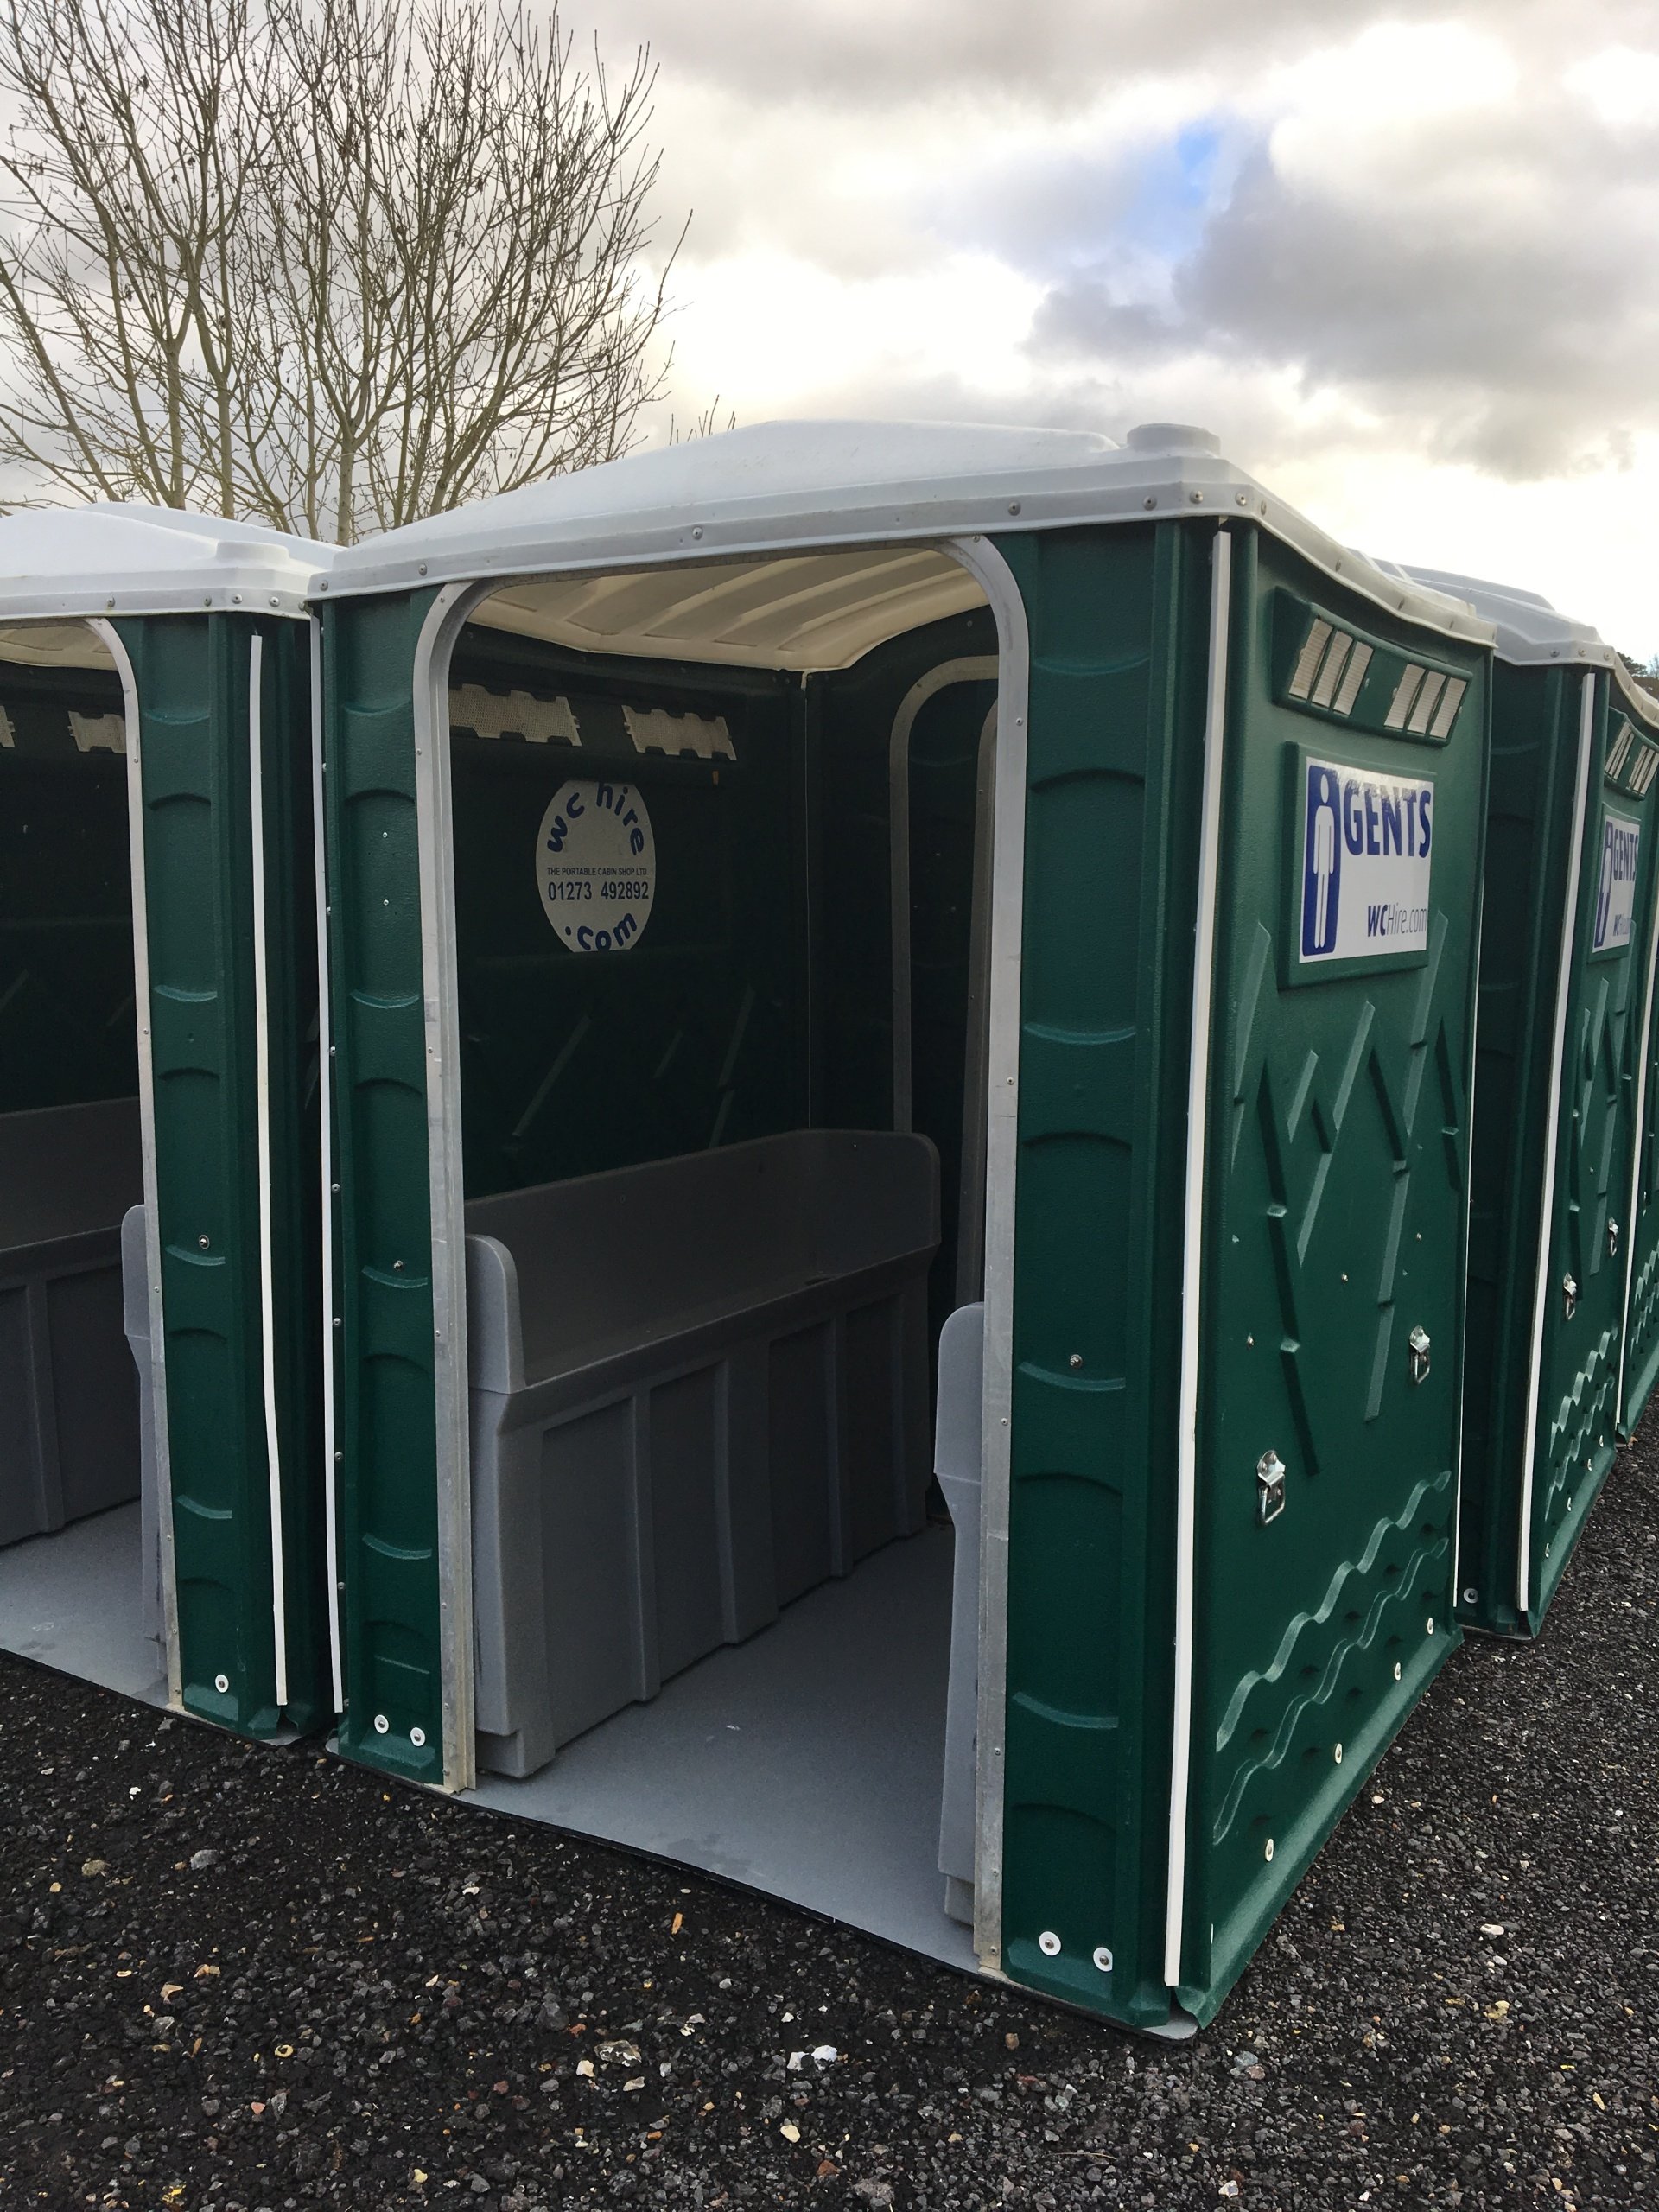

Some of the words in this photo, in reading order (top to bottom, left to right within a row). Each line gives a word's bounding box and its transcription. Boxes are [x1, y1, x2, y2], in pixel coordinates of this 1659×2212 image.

[547, 792, 585, 852] wc
[596, 781, 645, 855] hire
[1344, 779, 1432, 859] GENTS
[547, 867, 560, 876] THE
[562, 867, 596, 876] PORTABLE
[597, 867, 617, 876] CABIN
[619, 867, 635, 876] SHOP
[1613, 829, 1639, 881] GENTS
[548, 881, 592, 901] 01273
[601, 881, 649, 899] 492892
[565, 913, 638, 951] .com
[1367, 903, 1427, 938] WCHire.com
